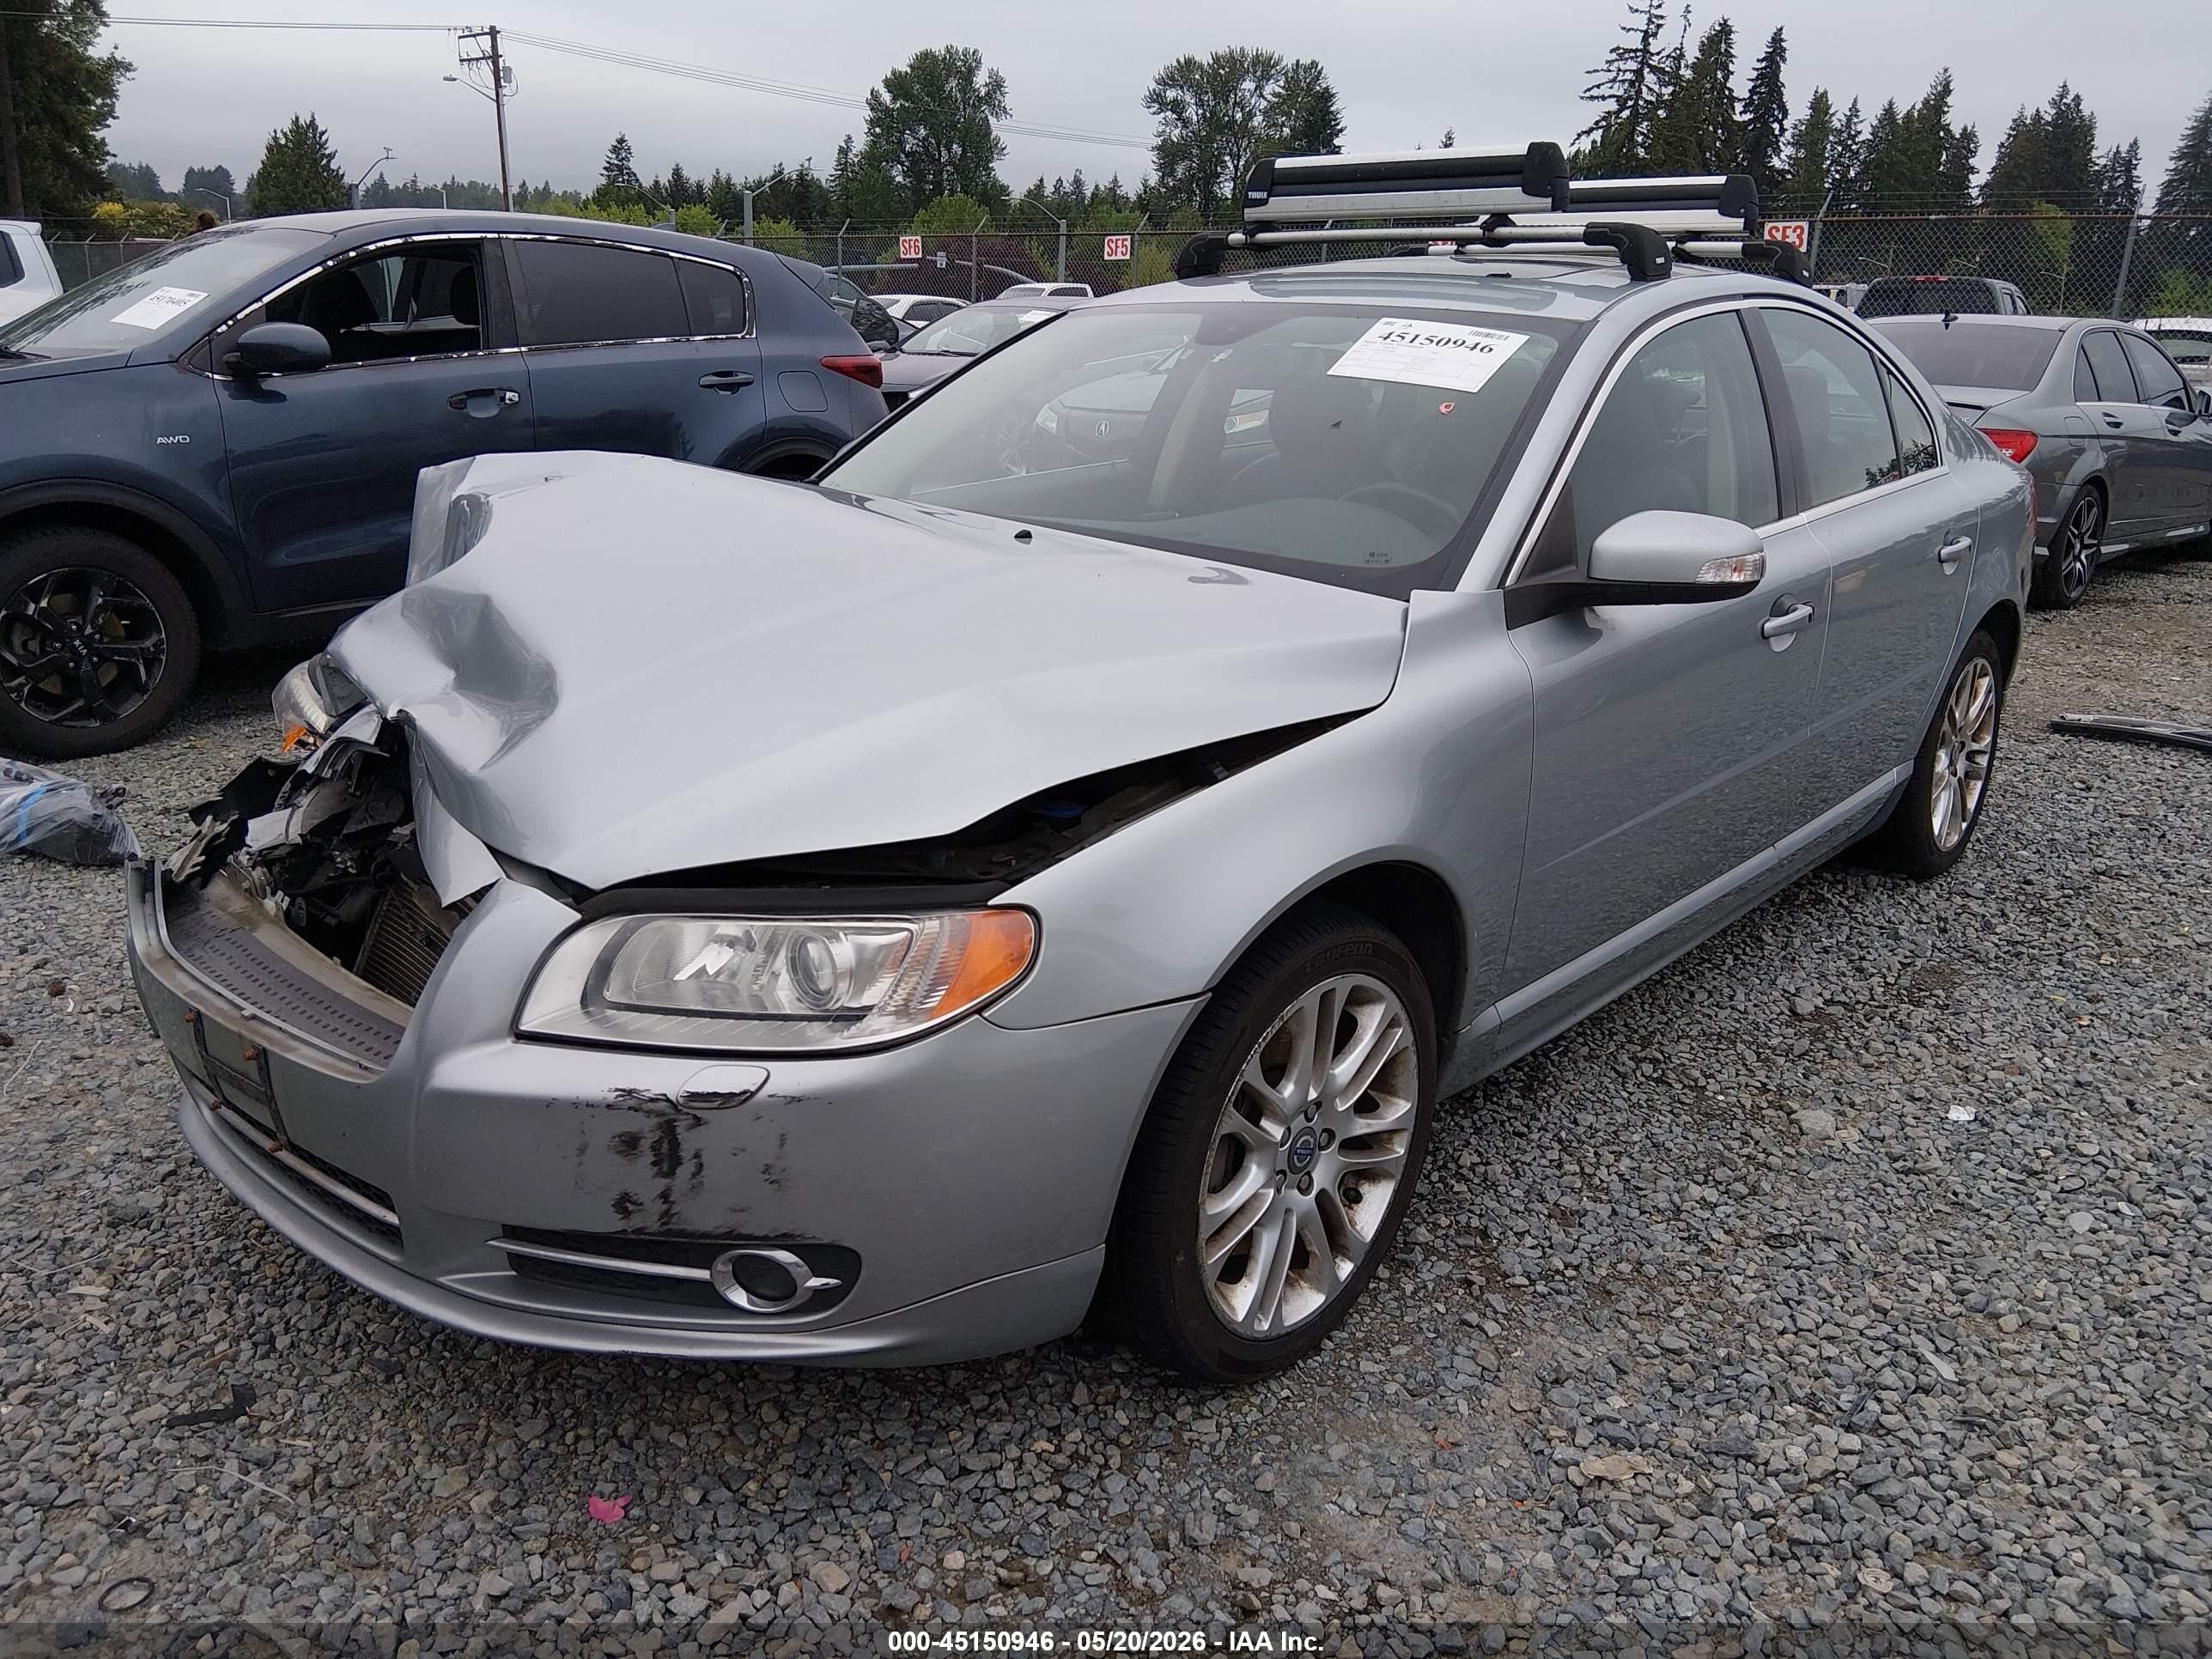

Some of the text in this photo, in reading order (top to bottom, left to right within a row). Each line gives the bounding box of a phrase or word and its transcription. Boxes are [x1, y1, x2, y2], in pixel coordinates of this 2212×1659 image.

[1768, 225, 1805, 249] SF3
[902, 238, 920, 256] SF6
[1106, 238, 1128, 257] SF5
[1378, 330, 1498, 355] 45150946
[156, 435, 190, 445] AWD
[74, 639, 88, 656] KIA
